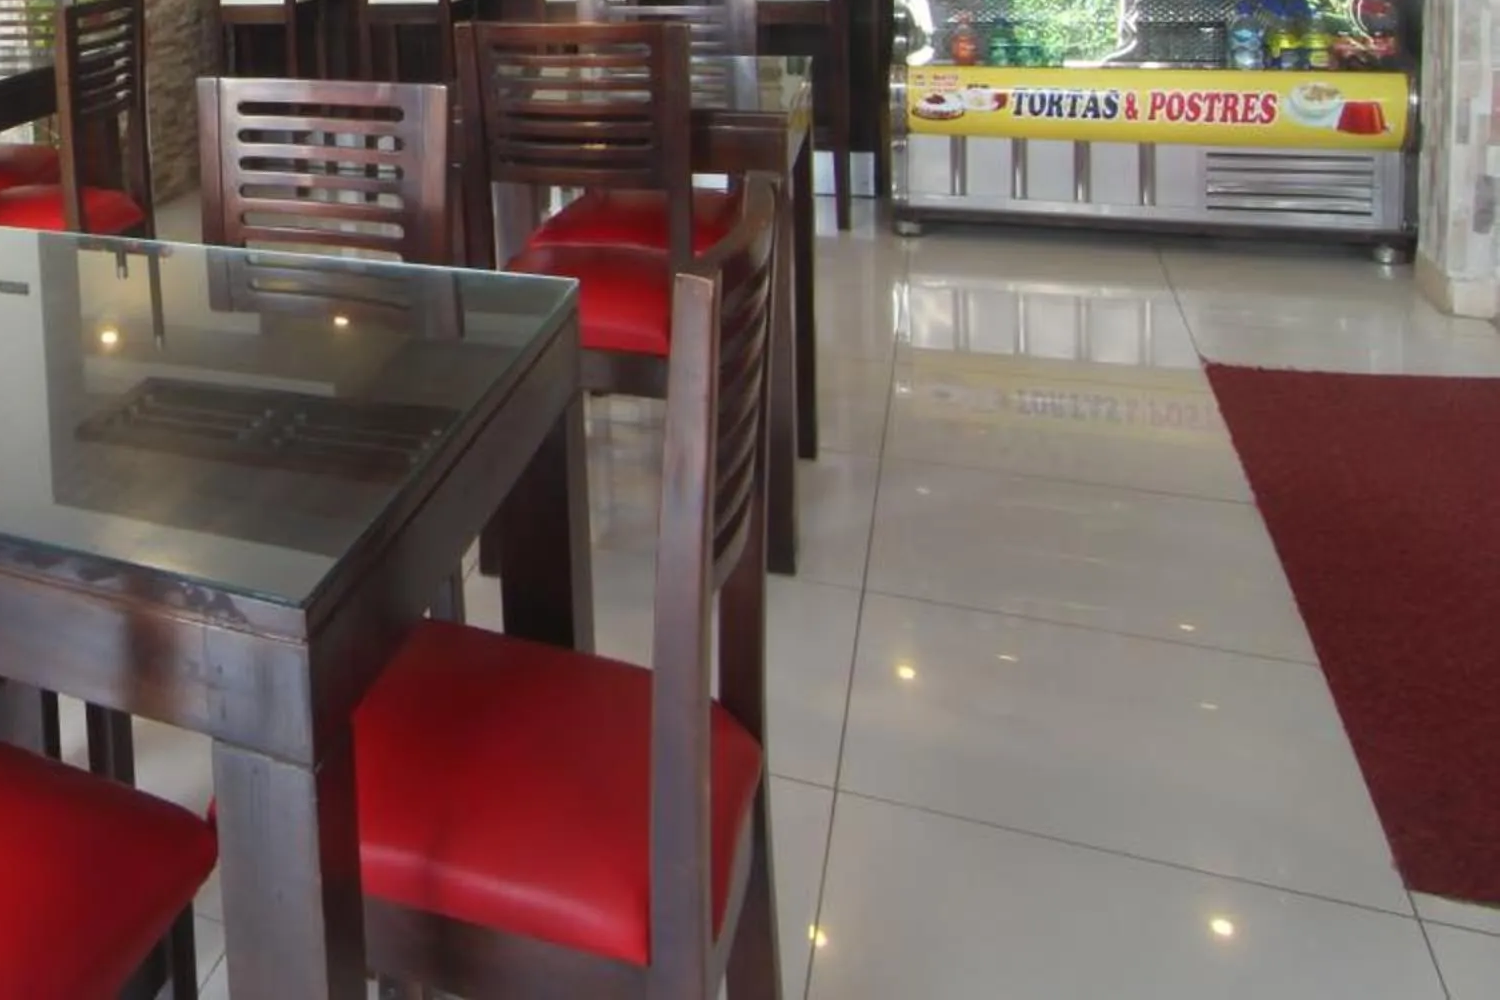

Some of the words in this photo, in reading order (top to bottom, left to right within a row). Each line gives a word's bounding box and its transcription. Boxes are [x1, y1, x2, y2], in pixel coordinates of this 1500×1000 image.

[1011, 88, 1120, 119] TORTAS
[1124, 91, 1139, 121] &
[1147, 91, 1278, 125] POSTRES
